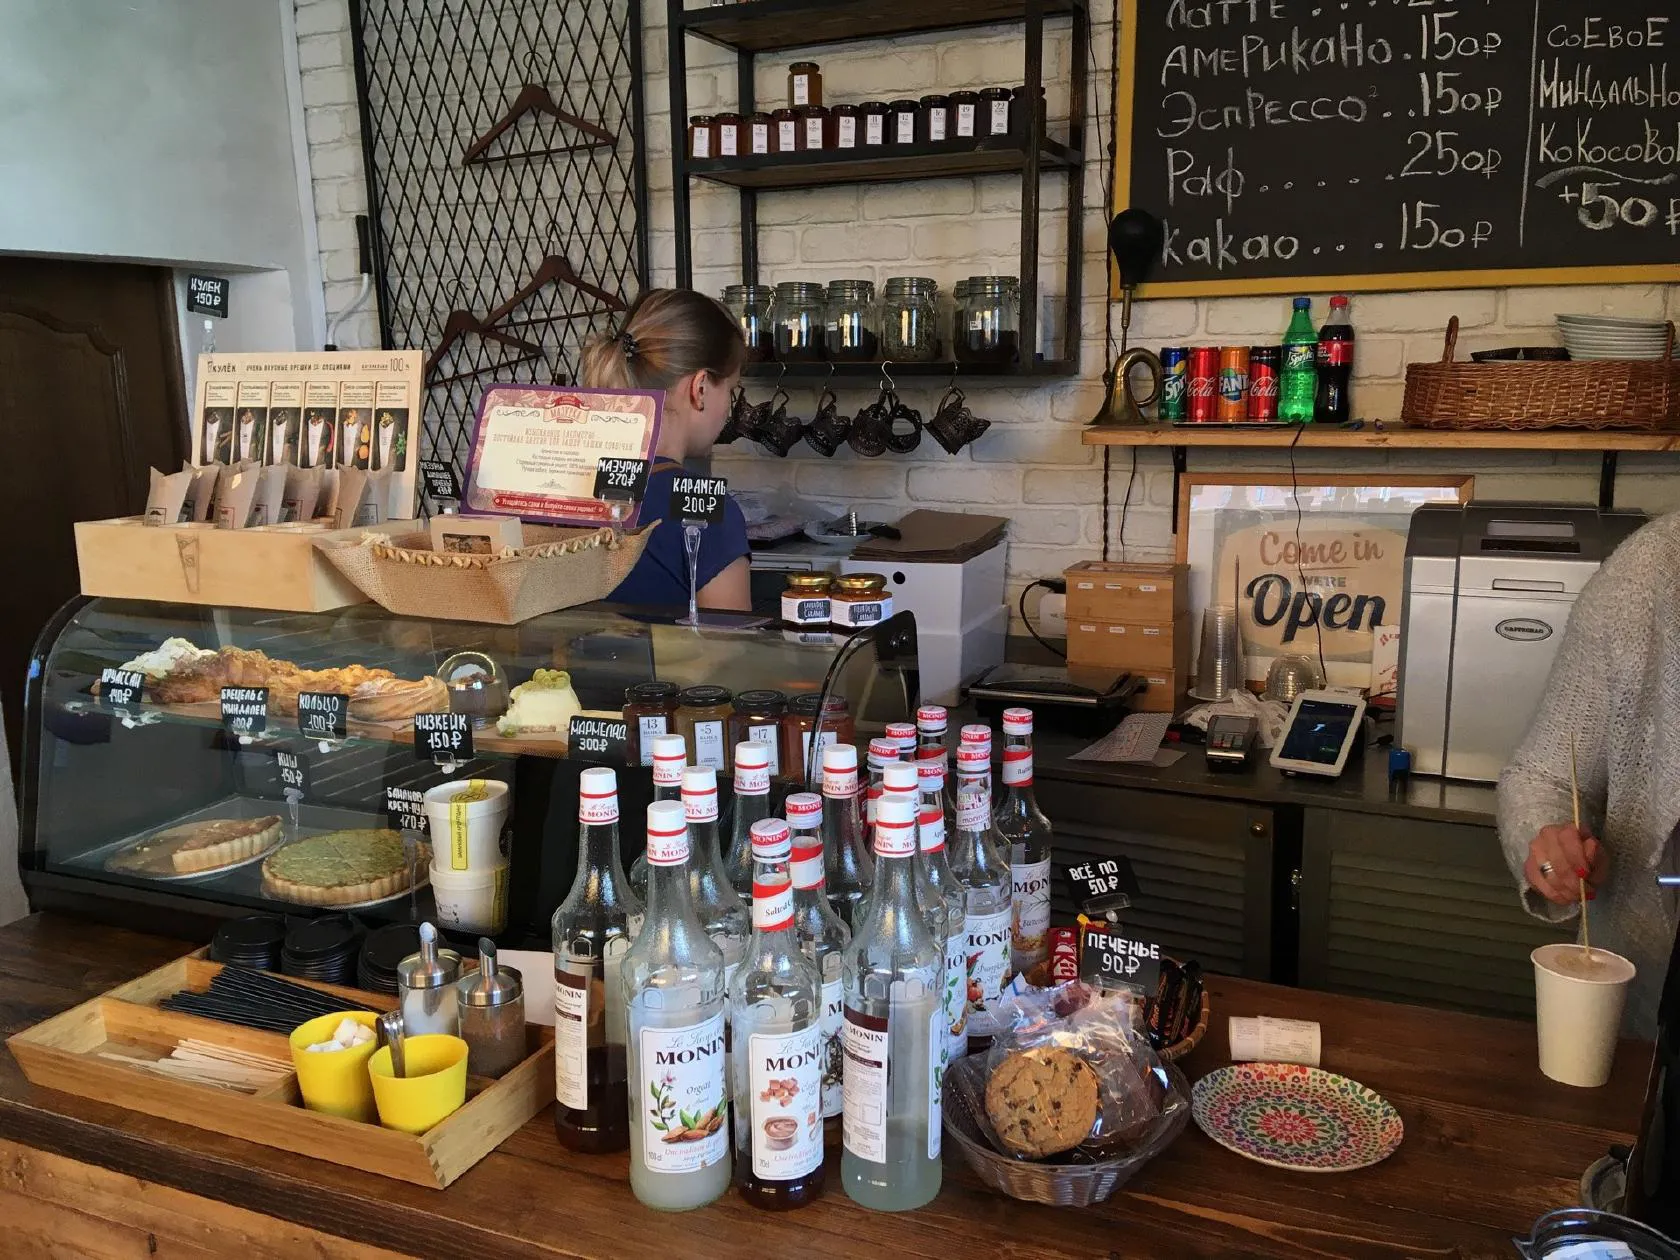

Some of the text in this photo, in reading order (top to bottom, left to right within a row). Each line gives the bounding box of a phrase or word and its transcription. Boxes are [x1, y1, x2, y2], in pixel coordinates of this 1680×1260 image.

[1167, 147, 1245, 216] Раф
[597, 459, 644, 474] МАЗУРКА
[607, 473, 636, 487] 270₽
[673, 477, 726, 496] КАРАМЕЛЬ
[682, 496, 717, 514] 200₽
[1259, 531, 1384, 566] Come in
[1244, 573, 1387, 646] Open
[299, 693, 339, 713] КОЛЬЦО
[308, 713, 337, 732] 100₽
[415, 712, 467, 732] ЧИЗКЕЙК
[570, 720, 627, 741] МАРМЕЛАД
[427, 731, 462, 749] 150₽
[579, 738, 609, 753] 300₽
[387, 787, 424, 803] БАНАНОВ
[588, 808, 618, 817] MONIN
[400, 814, 427, 831] 170₽
[752, 831, 783, 842] MONIN
[1069, 862, 1095, 881] ВСЁ
[1098, 860, 1119, 875] ПО
[1088, 876, 1119, 895] 50₽
[1088, 932, 1160, 960] ПЕЧЕНЬЕ
[1102, 953, 1140, 978] 90₽
[766, 1043, 820, 1072] MONI
